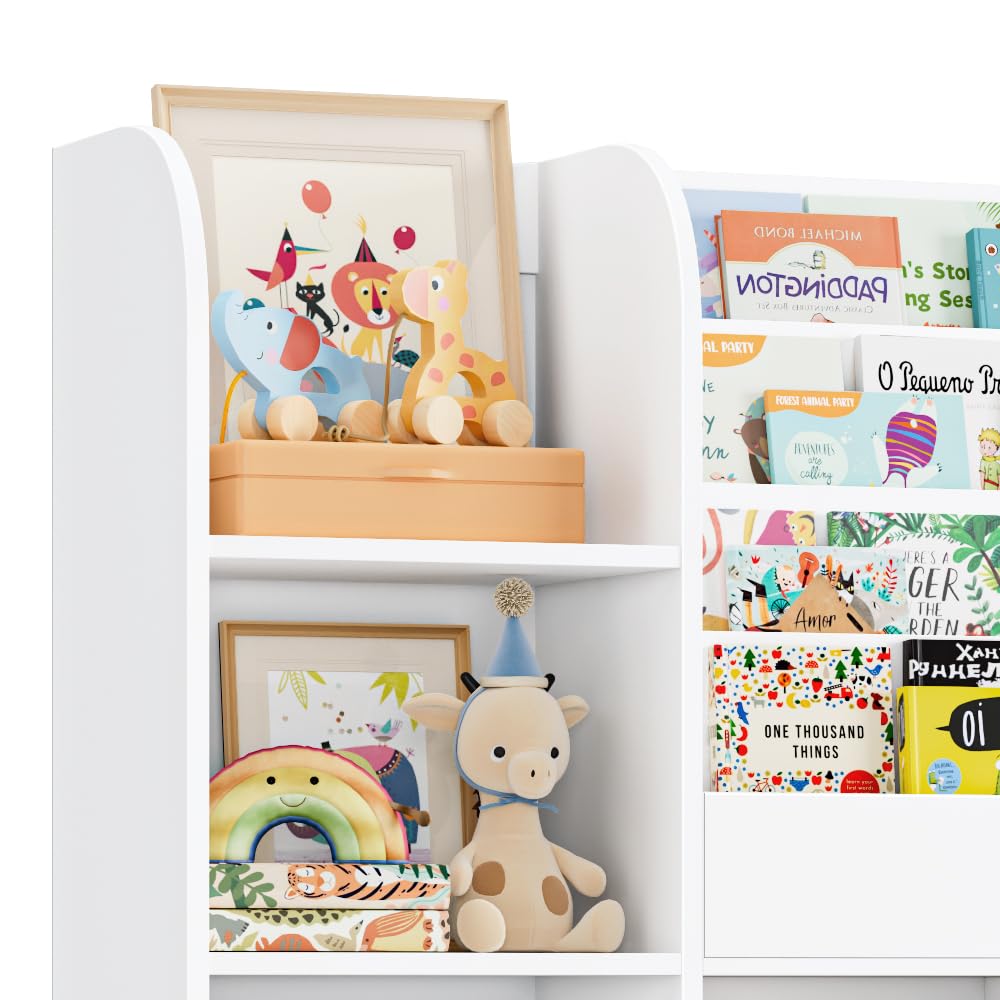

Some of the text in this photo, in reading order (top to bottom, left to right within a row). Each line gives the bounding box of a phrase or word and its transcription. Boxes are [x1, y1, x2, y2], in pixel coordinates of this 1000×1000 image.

[703, 340, 754, 354] AL PARTY
[878, 361, 894, 391] O
[899, 361, 974, 394] Pequeno
[775, 396, 855, 407] FOREST ANIMAL PARTY
[807, 457, 823, 465] are
[800, 466, 832, 485] calling
[942, 552, 949, 565] A
[908, 566, 961, 602] GER
[918, 602, 944, 617] THE
[794, 607, 837, 631] Amor
[764, 724, 865, 739] ONE THOUSAND
[793, 745, 839, 759] THINGS
